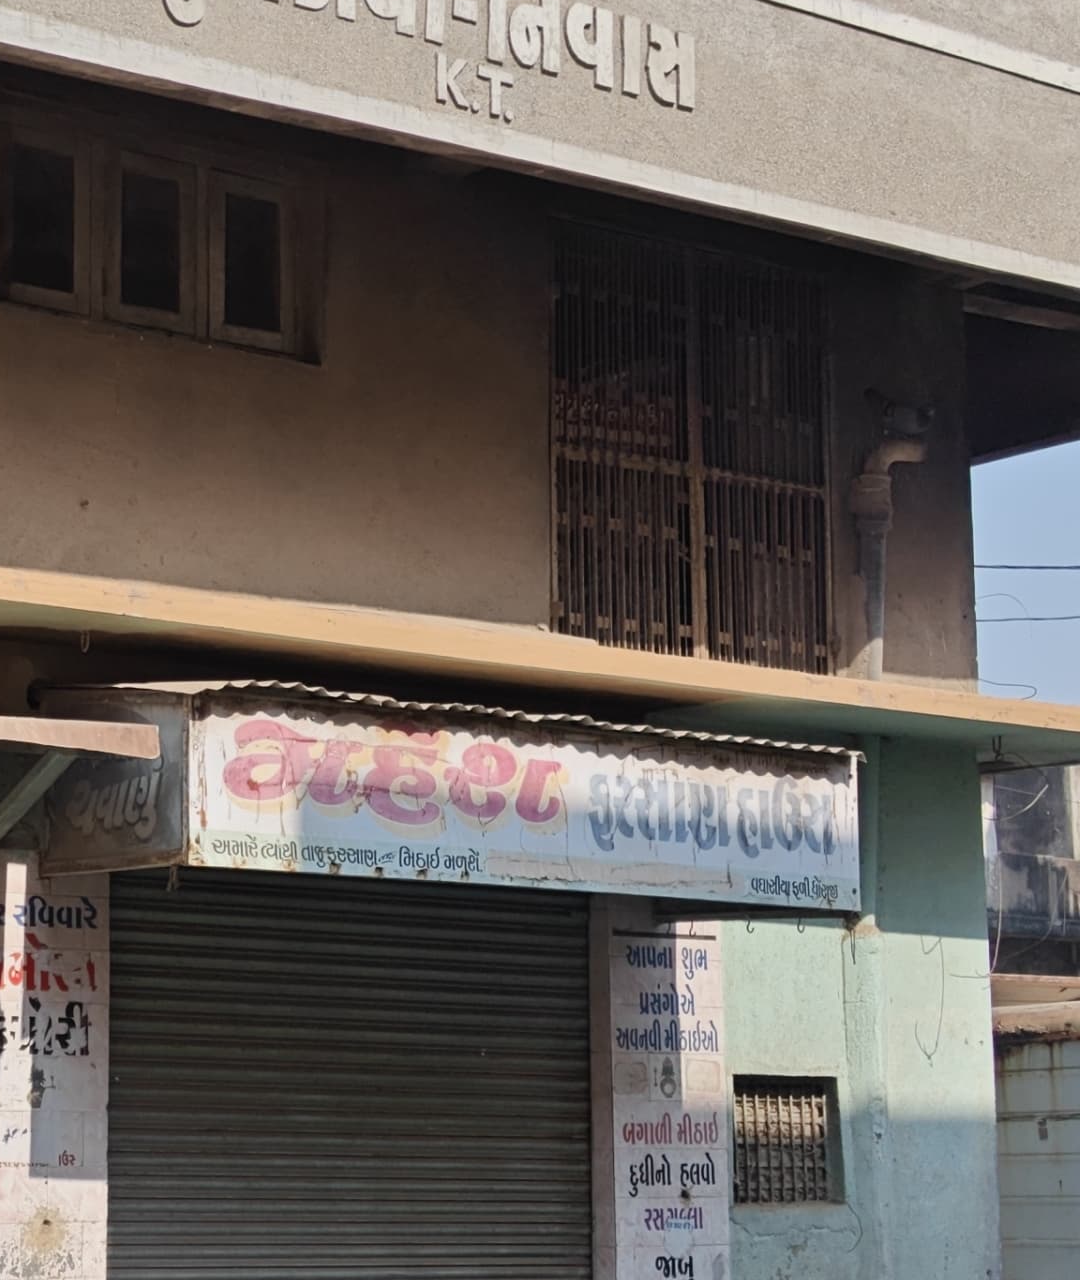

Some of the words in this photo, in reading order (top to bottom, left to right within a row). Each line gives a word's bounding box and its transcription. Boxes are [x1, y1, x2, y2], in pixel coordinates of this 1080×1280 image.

[433, 52, 515, 122] K.T.
[13, 896, 98, 929] રવિવારે
[625, 943, 673, 970] આપના
[681, 945, 708, 981] શુભ
[680, 1151, 716, 1187] હલવો
